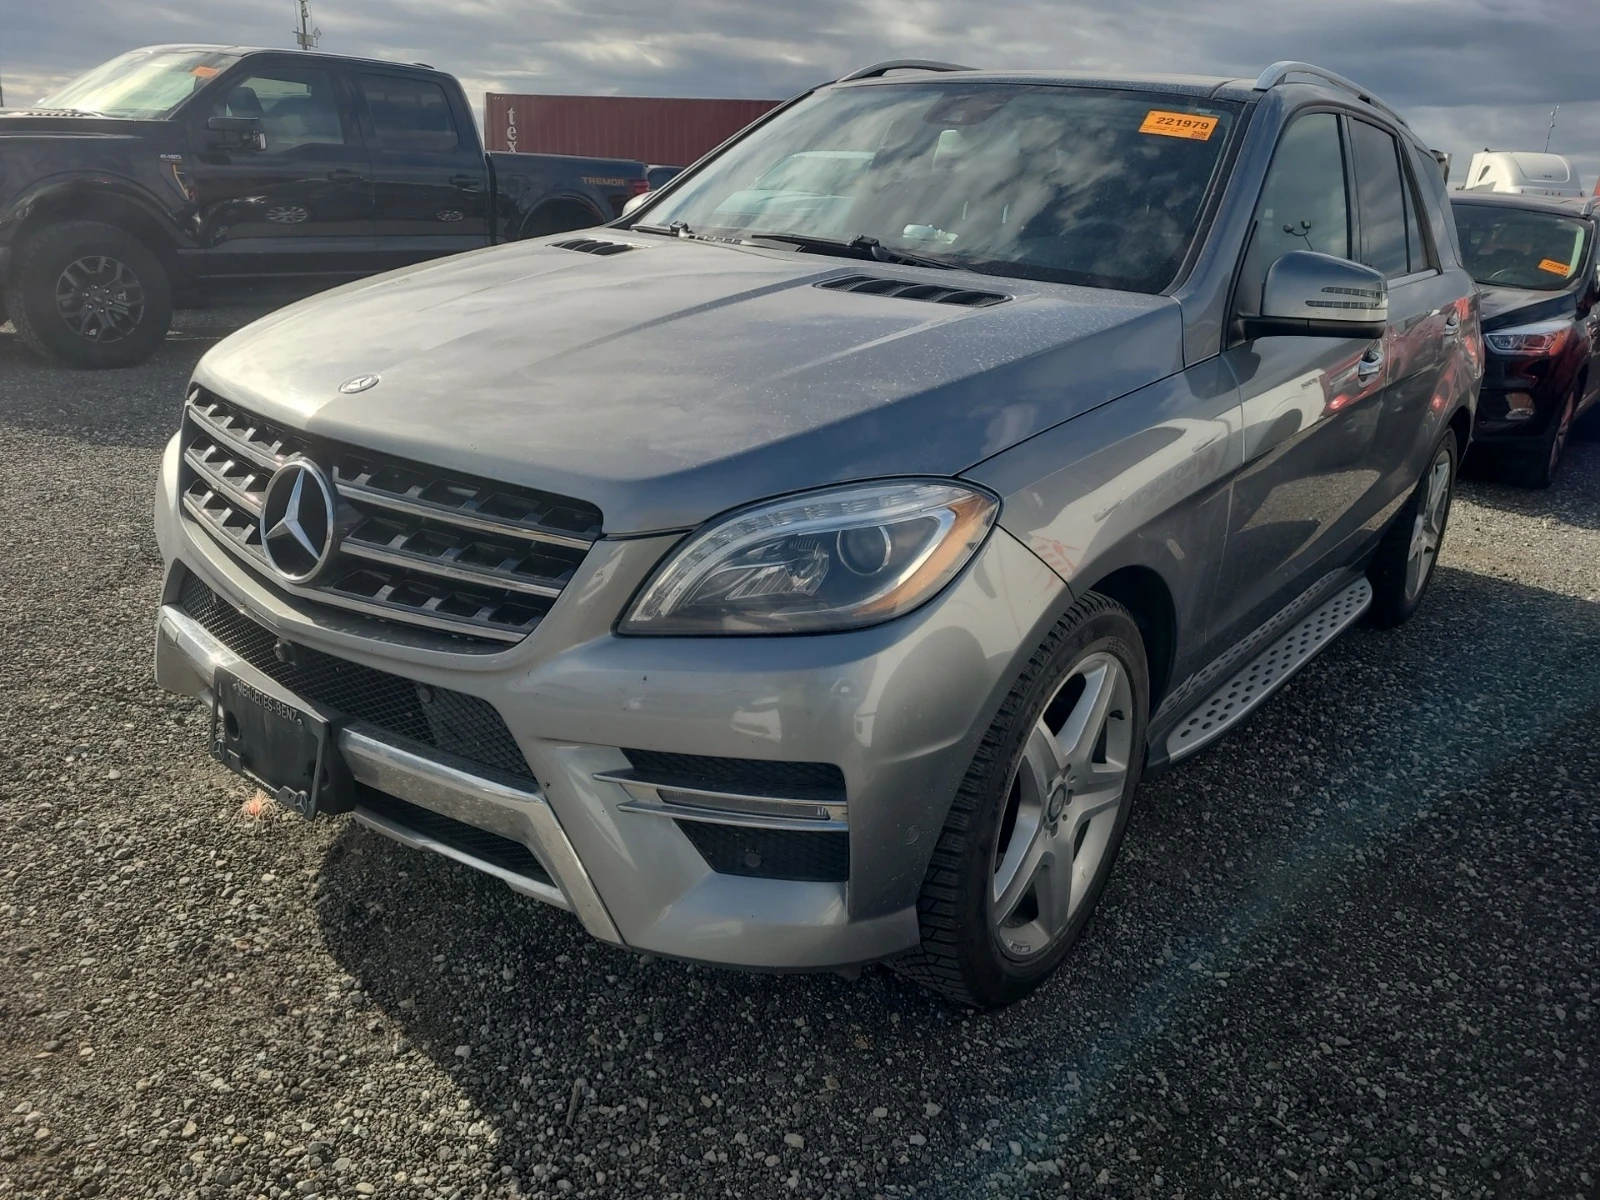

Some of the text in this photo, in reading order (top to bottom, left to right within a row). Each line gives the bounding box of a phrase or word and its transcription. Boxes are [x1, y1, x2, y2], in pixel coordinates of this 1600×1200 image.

[506, 106, 518, 153] tex
[1156, 116, 1209, 130] 221979
[581, 176, 625, 187] TREMOR
[236, 678, 299, 724] MERCEDES-BENZ
